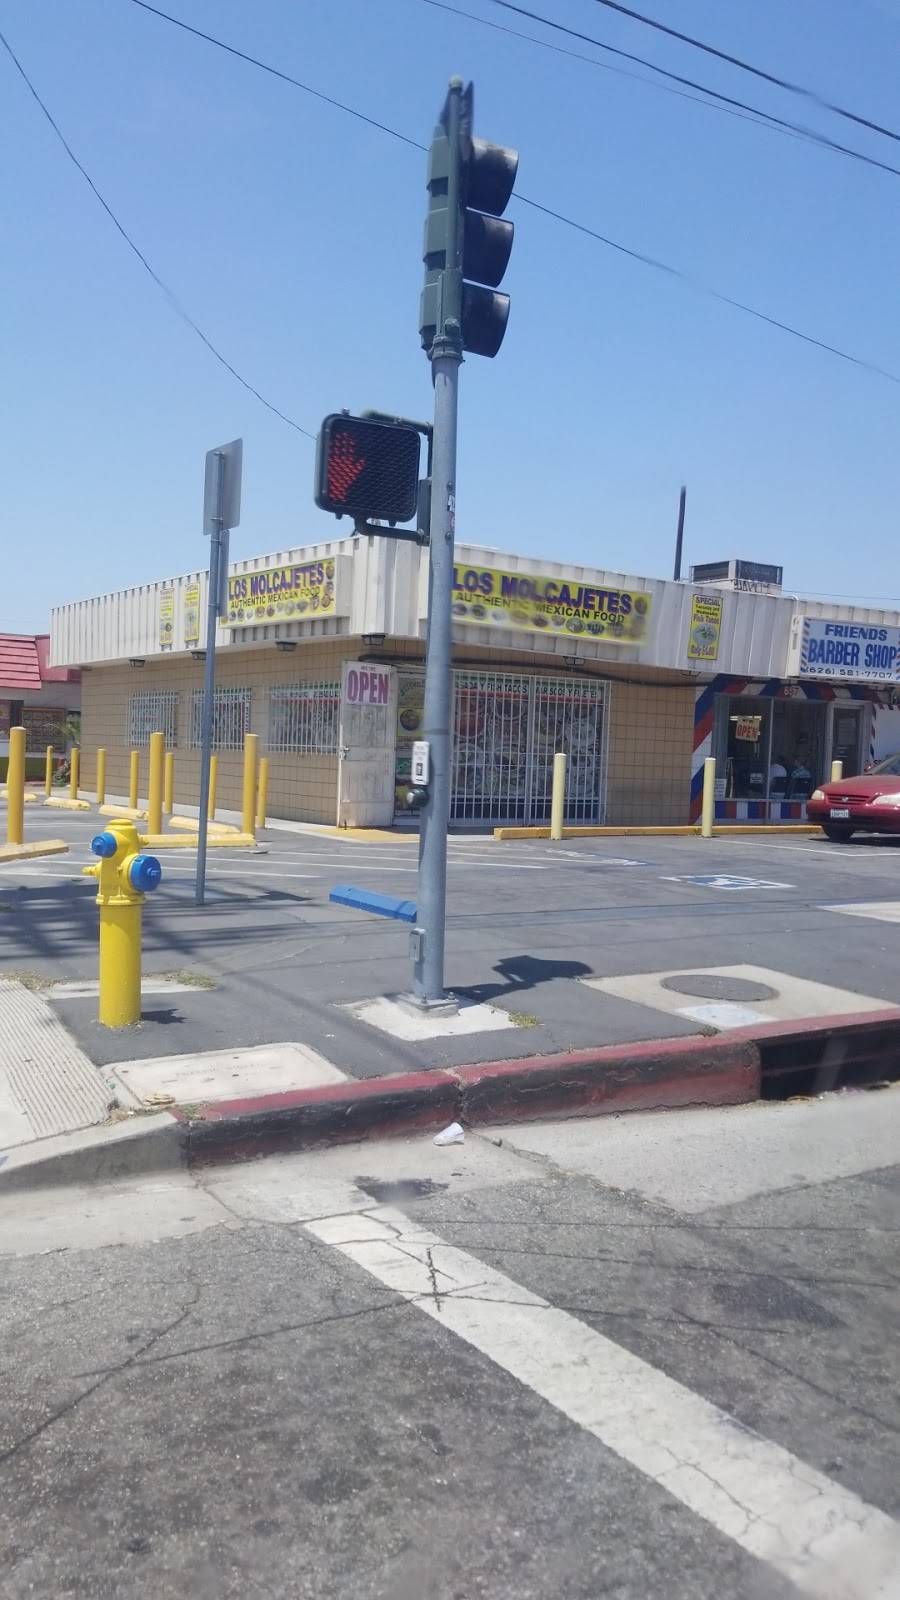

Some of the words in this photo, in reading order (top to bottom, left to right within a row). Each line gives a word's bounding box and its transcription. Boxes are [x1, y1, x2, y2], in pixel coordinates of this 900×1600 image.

[229, 577, 247, 600] LOS
[251, 562, 324, 597] MOLCAJETES
[452, 567, 494, 595] LOS
[501, 575, 632, 615] MOLCAJETES
[231, 596, 266, 609] AUTHENTIC
[268, 590, 299, 603] MEXICAN
[301, 585, 320, 597] FOOD
[456, 592, 531, 611] AUTHEN
[535, 601, 590, 619] MEXICAN
[593, 610, 625, 624] FOOD
[825, 623, 888, 641] FRIENDS
[808, 638, 860, 667] BARBER
[864, 643, 897, 669] SHOP
[347, 669, 389, 705] OPEN
[806, 666, 835, 675] (626)
[840, 668, 892, 679] 581-7707
[737, 723, 757, 737] OPEN
